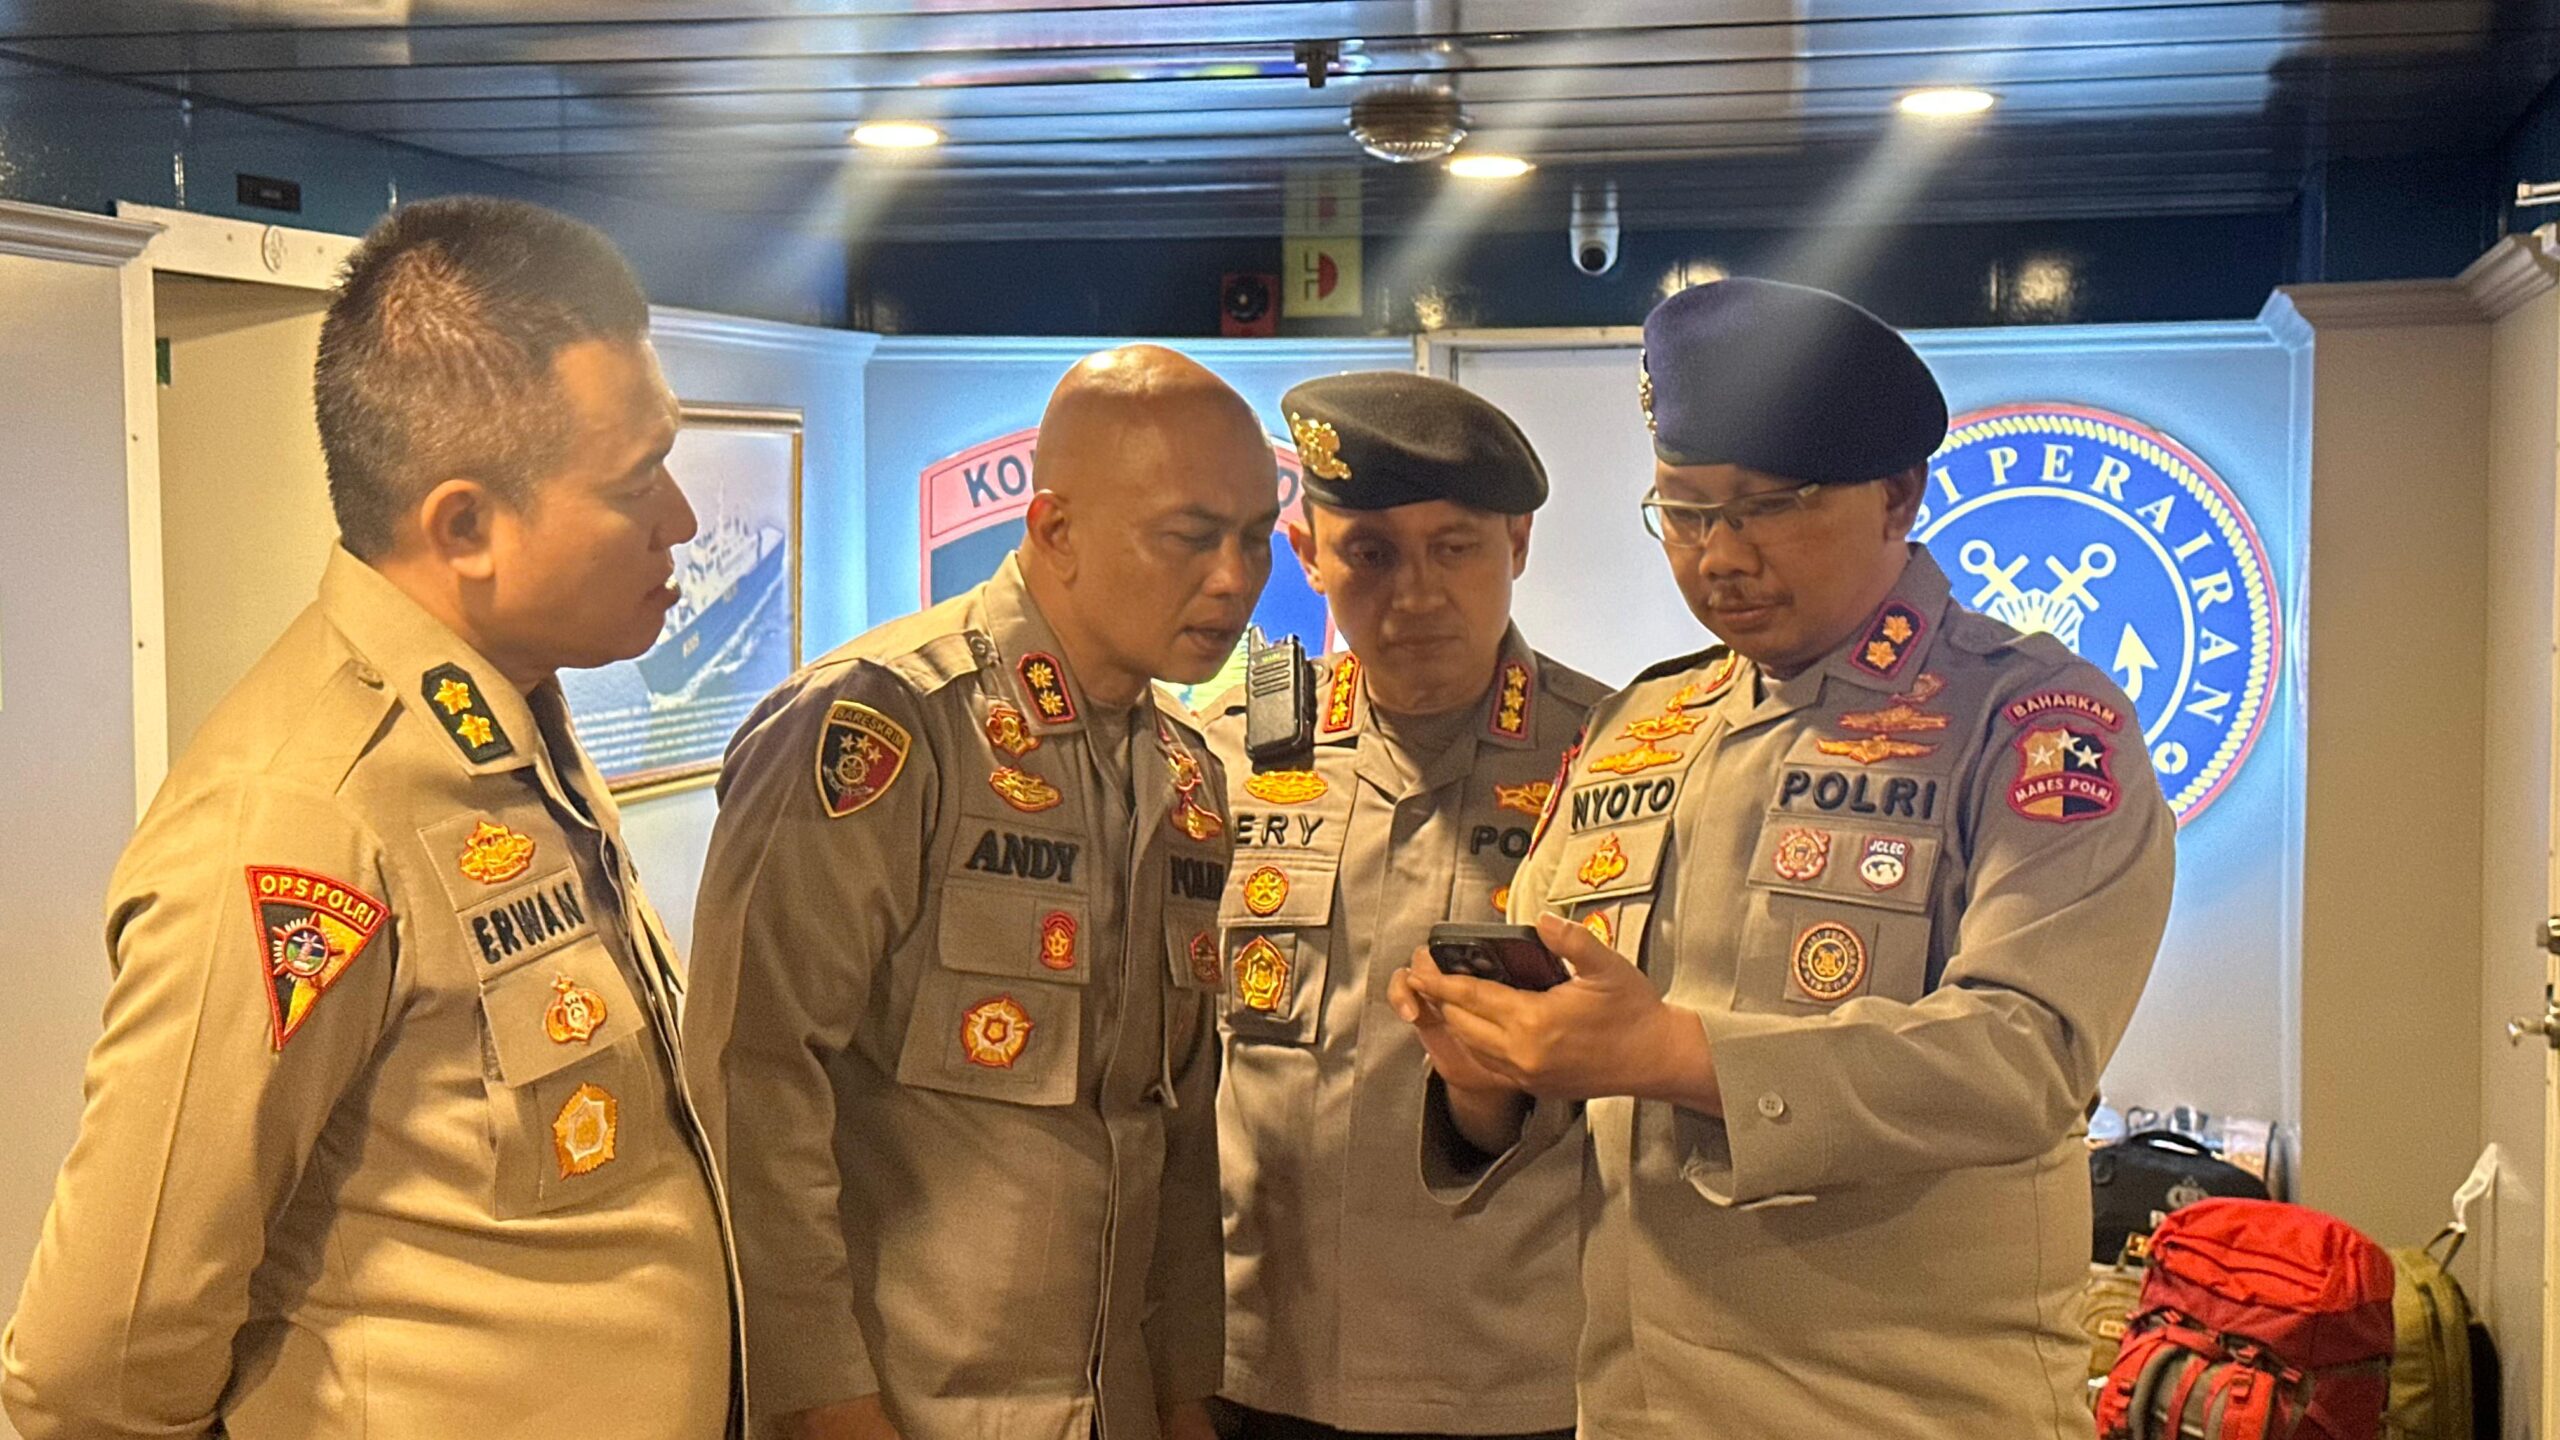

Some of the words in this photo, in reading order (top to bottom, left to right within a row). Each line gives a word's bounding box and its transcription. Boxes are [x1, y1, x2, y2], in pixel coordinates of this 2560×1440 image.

[1989, 442, 2240, 725] PERAIRAN
[1571, 776, 1675, 832] NYOTO
[1779, 769, 1937, 820] POLRI
[2015, 778, 2064, 803] MABES
[2069, 778, 2112, 801] POLRI
[965, 829, 1079, 883] ANDY
[1869, 840, 1905, 855] JCLEC
[259, 875, 311, 898] OPS
[312, 883, 376, 927] POLRI
[472, 881, 585, 965] ERWAN
